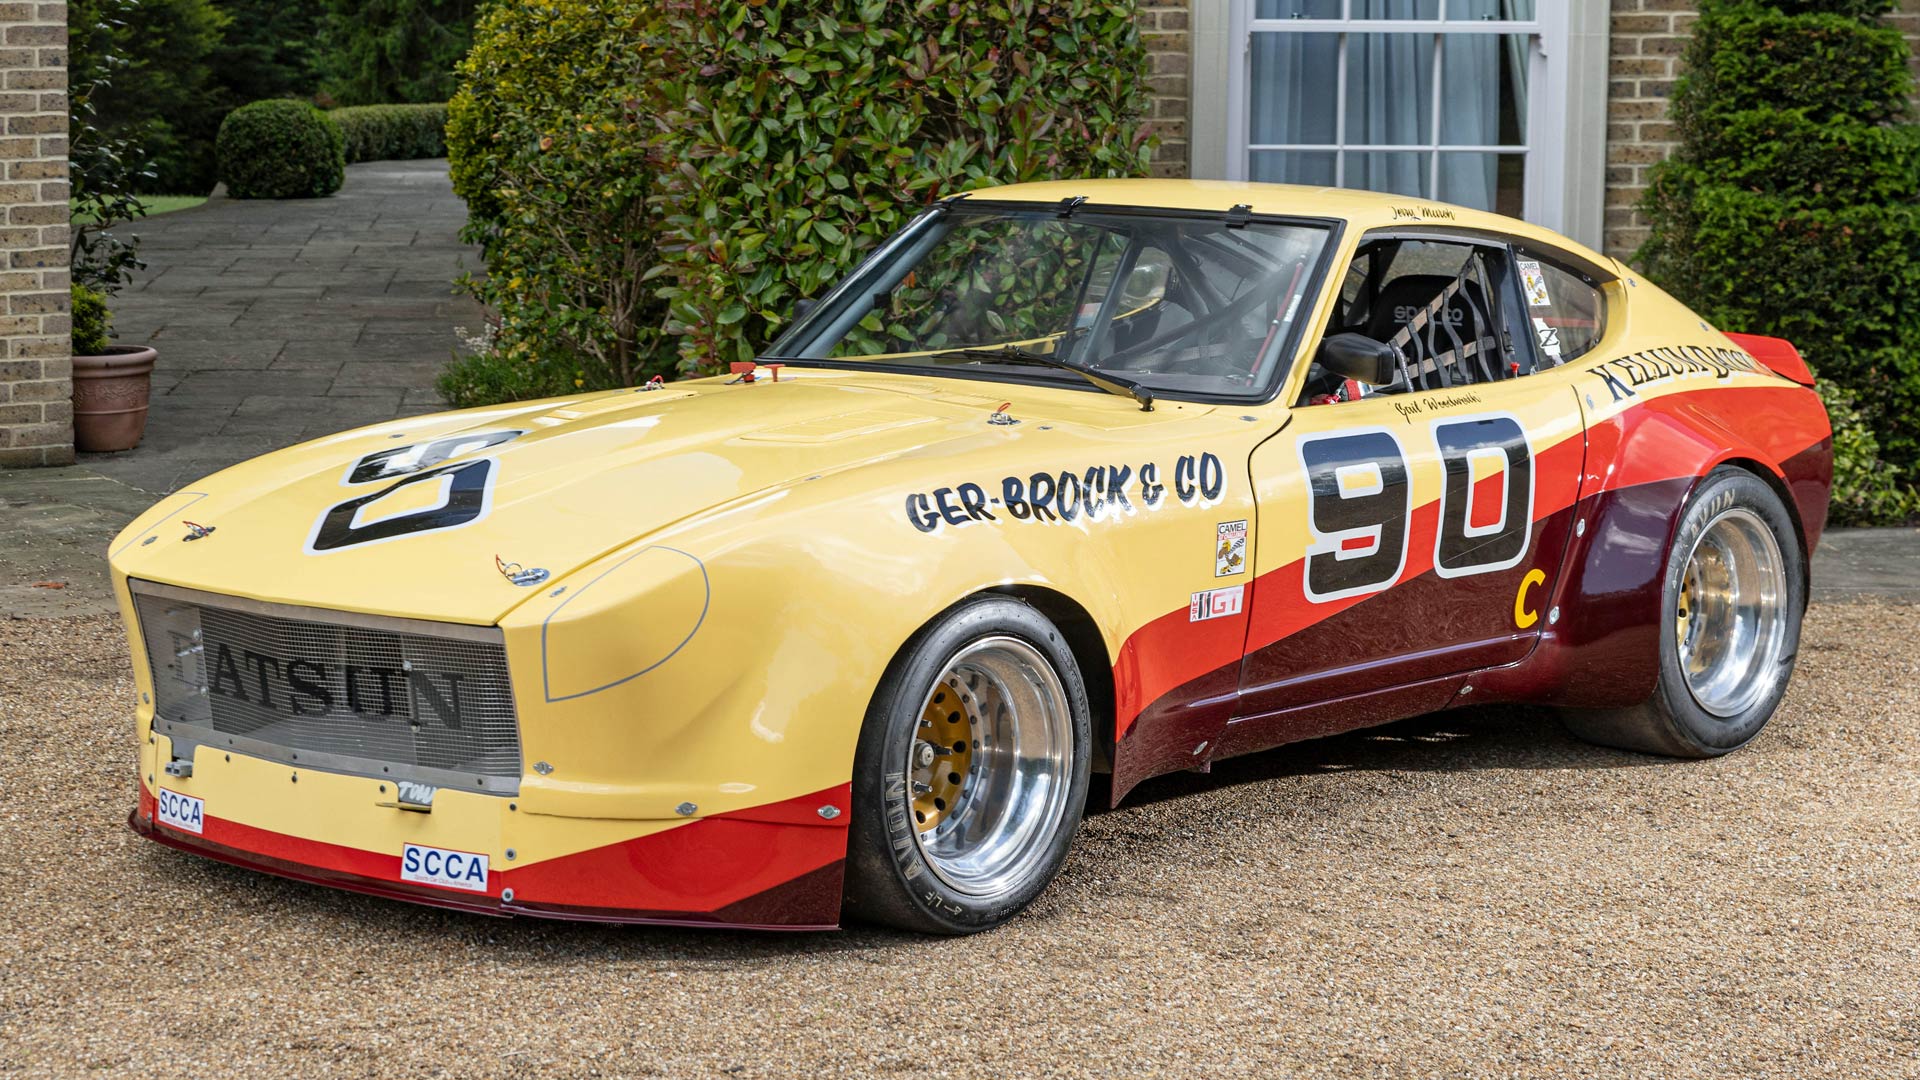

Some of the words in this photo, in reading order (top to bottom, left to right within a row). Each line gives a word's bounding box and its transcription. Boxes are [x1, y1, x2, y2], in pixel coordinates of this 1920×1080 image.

[1520, 262, 1538, 270] CAMEL
[1394, 306, 1463, 323] spo
[1395, 401, 1422, 424] Gail
[904, 463, 1133, 533] GER-BROCK
[1139, 462, 1163, 506] &
[1174, 452, 1223, 503] CO
[1299, 413, 1533, 601] 90
[1218, 522, 1246, 534] CAMEL
[1211, 589, 1242, 614] GT
[1514, 568, 1546, 629] C
[169, 629, 465, 730] DATSUN
[160, 791, 201, 825] SCCA
[398, 781, 437, 804] TOW
[885, 771, 925, 882] AVON
[405, 847, 485, 883] SCCA
